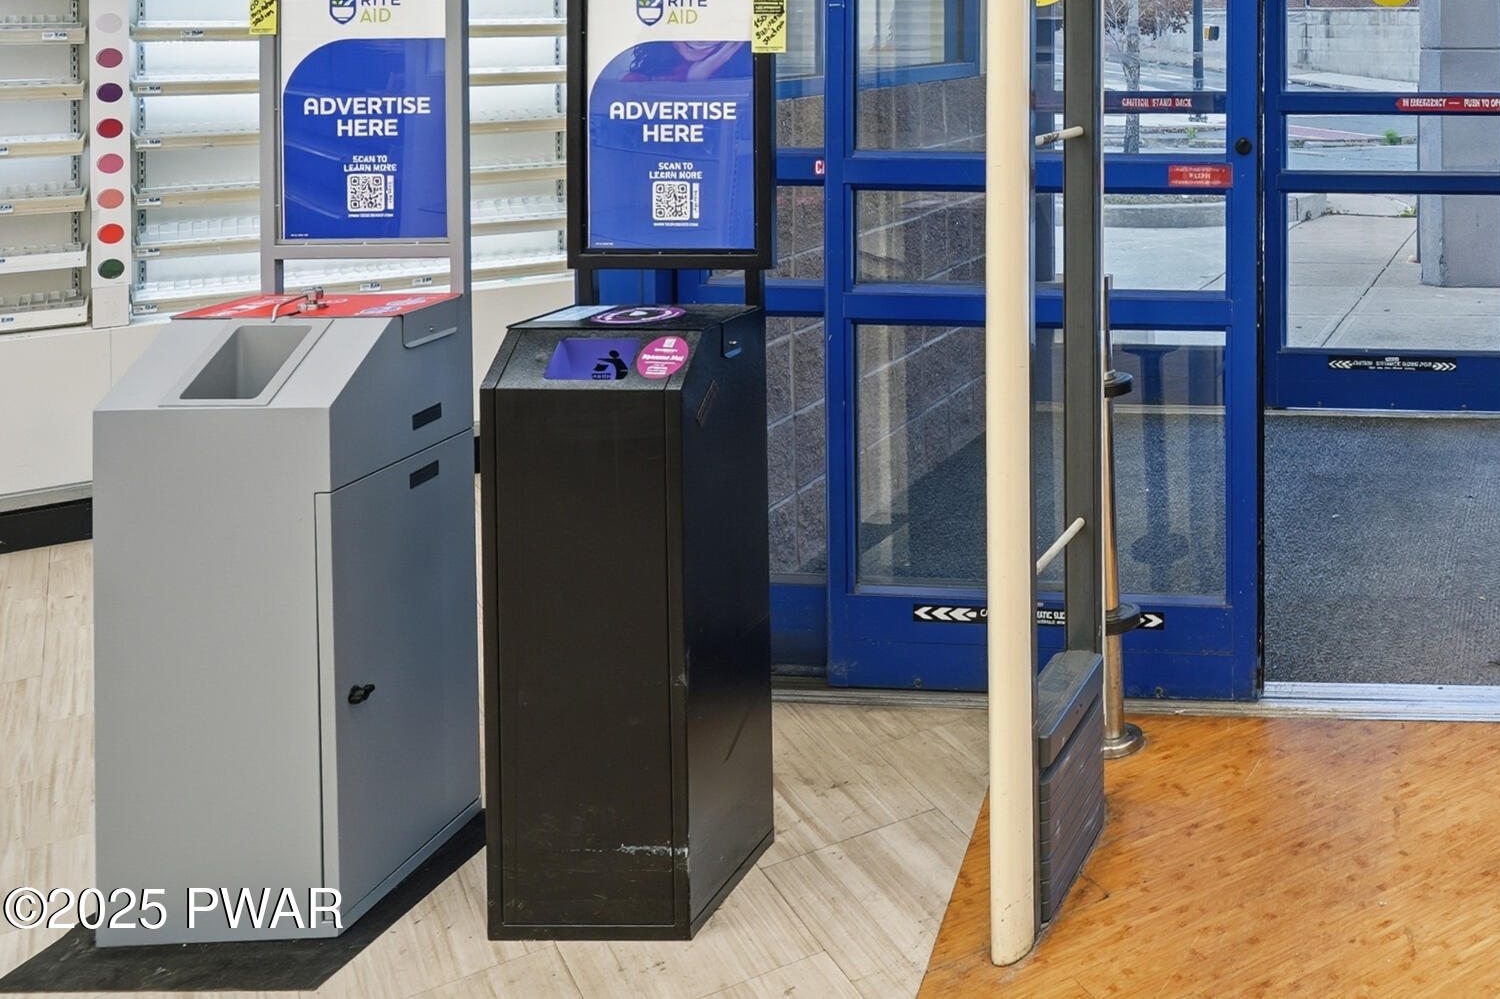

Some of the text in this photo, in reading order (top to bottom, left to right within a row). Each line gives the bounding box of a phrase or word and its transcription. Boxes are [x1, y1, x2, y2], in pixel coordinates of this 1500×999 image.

[360, 8, 391, 23] AID
[667, 9, 698, 24] AID
[304, 97, 431, 115] ADVERTISE
[610, 102, 737, 120] ADVERTISE
[337, 119, 398, 136] HERE
[643, 124, 704, 142] HERE
[352, 155, 375, 163] SCAN
[658, 162, 693, 170] SCAN TO
[343, 164, 371, 172] LEARN
